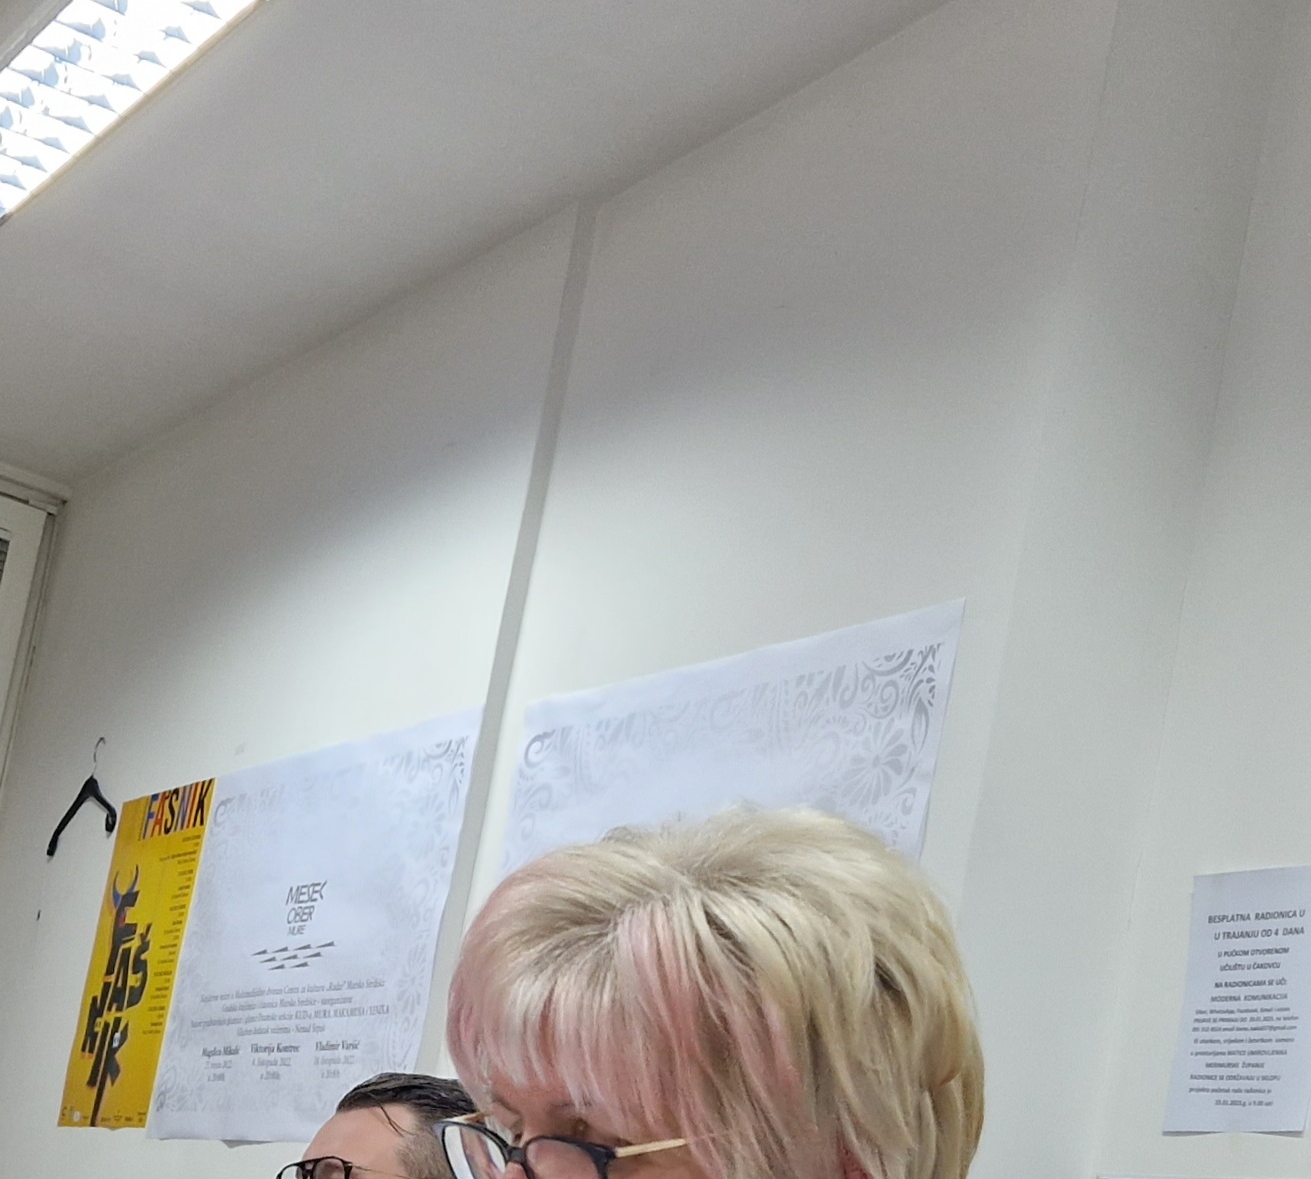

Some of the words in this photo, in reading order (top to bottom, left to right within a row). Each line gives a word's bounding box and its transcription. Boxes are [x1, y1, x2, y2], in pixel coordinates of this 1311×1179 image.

[287, 906, 315, 924] OBER
[1207, 913, 1251, 924] BESPLATNA
[1254, 910, 1297, 920] RADIONICA
[1299, 909, 1306, 918] U
[1213, 932, 1221, 941] U
[1222, 929, 1259, 940] TRAJANJU
[1260, 929, 1273, 938] OD
[1274, 928, 1279, 937] 4
[1282, 926, 1305, 936] DANA
